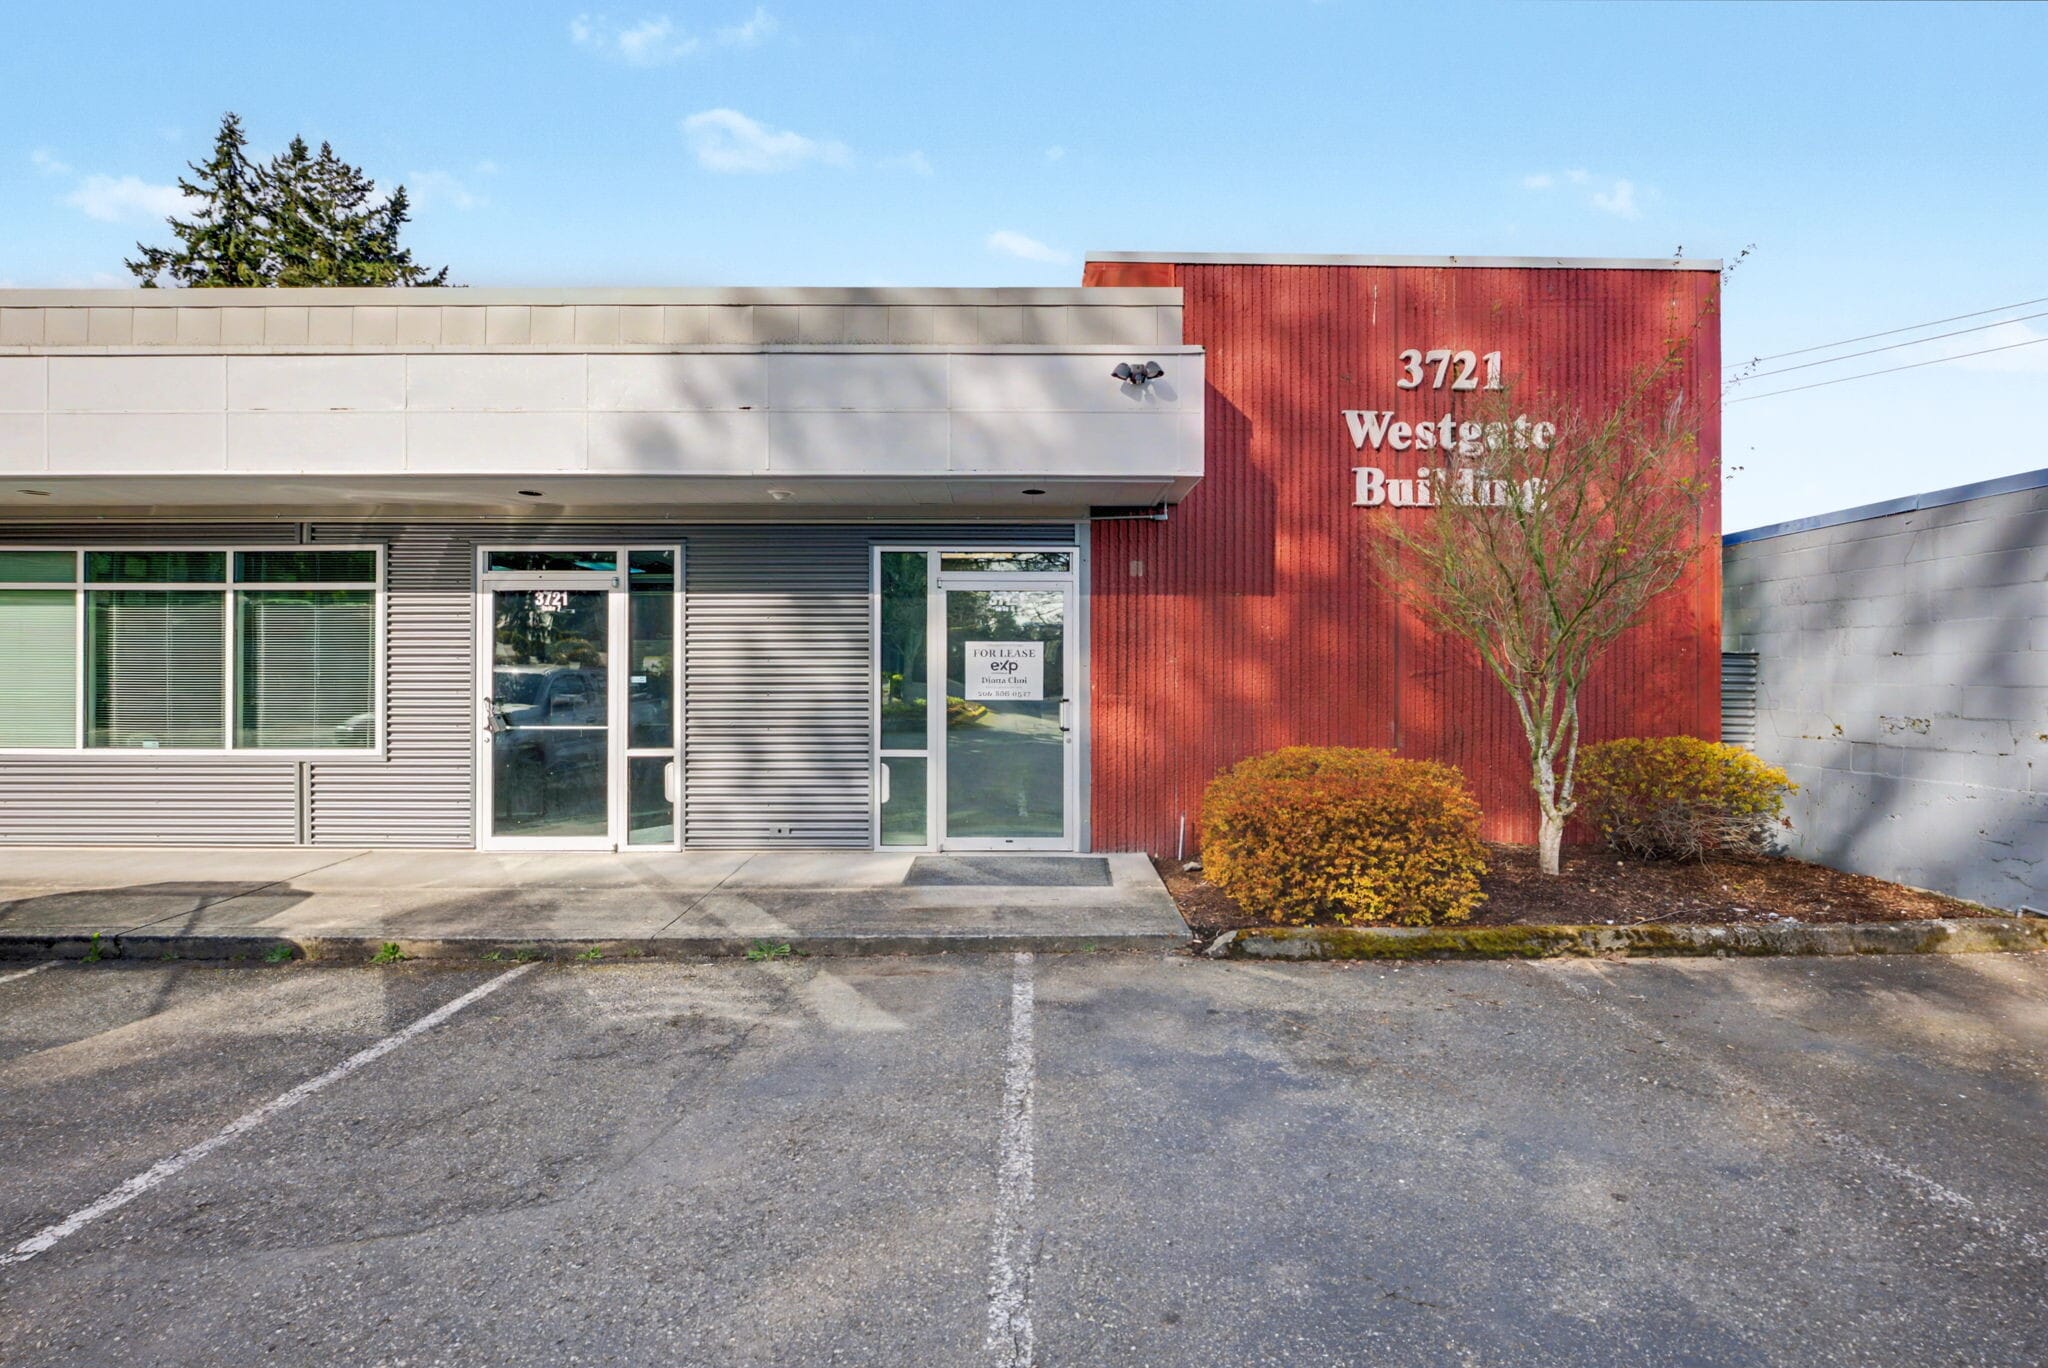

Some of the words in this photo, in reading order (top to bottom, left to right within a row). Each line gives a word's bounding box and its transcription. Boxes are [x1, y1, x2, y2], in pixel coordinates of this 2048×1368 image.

[1397, 349, 1504, 390] 3721
[1341, 410, 1556, 457] Westgate
[534, 591, 568, 606] 3721
[973, 649, 996, 658] FOR
[1000, 649, 1036, 658] LEASE
